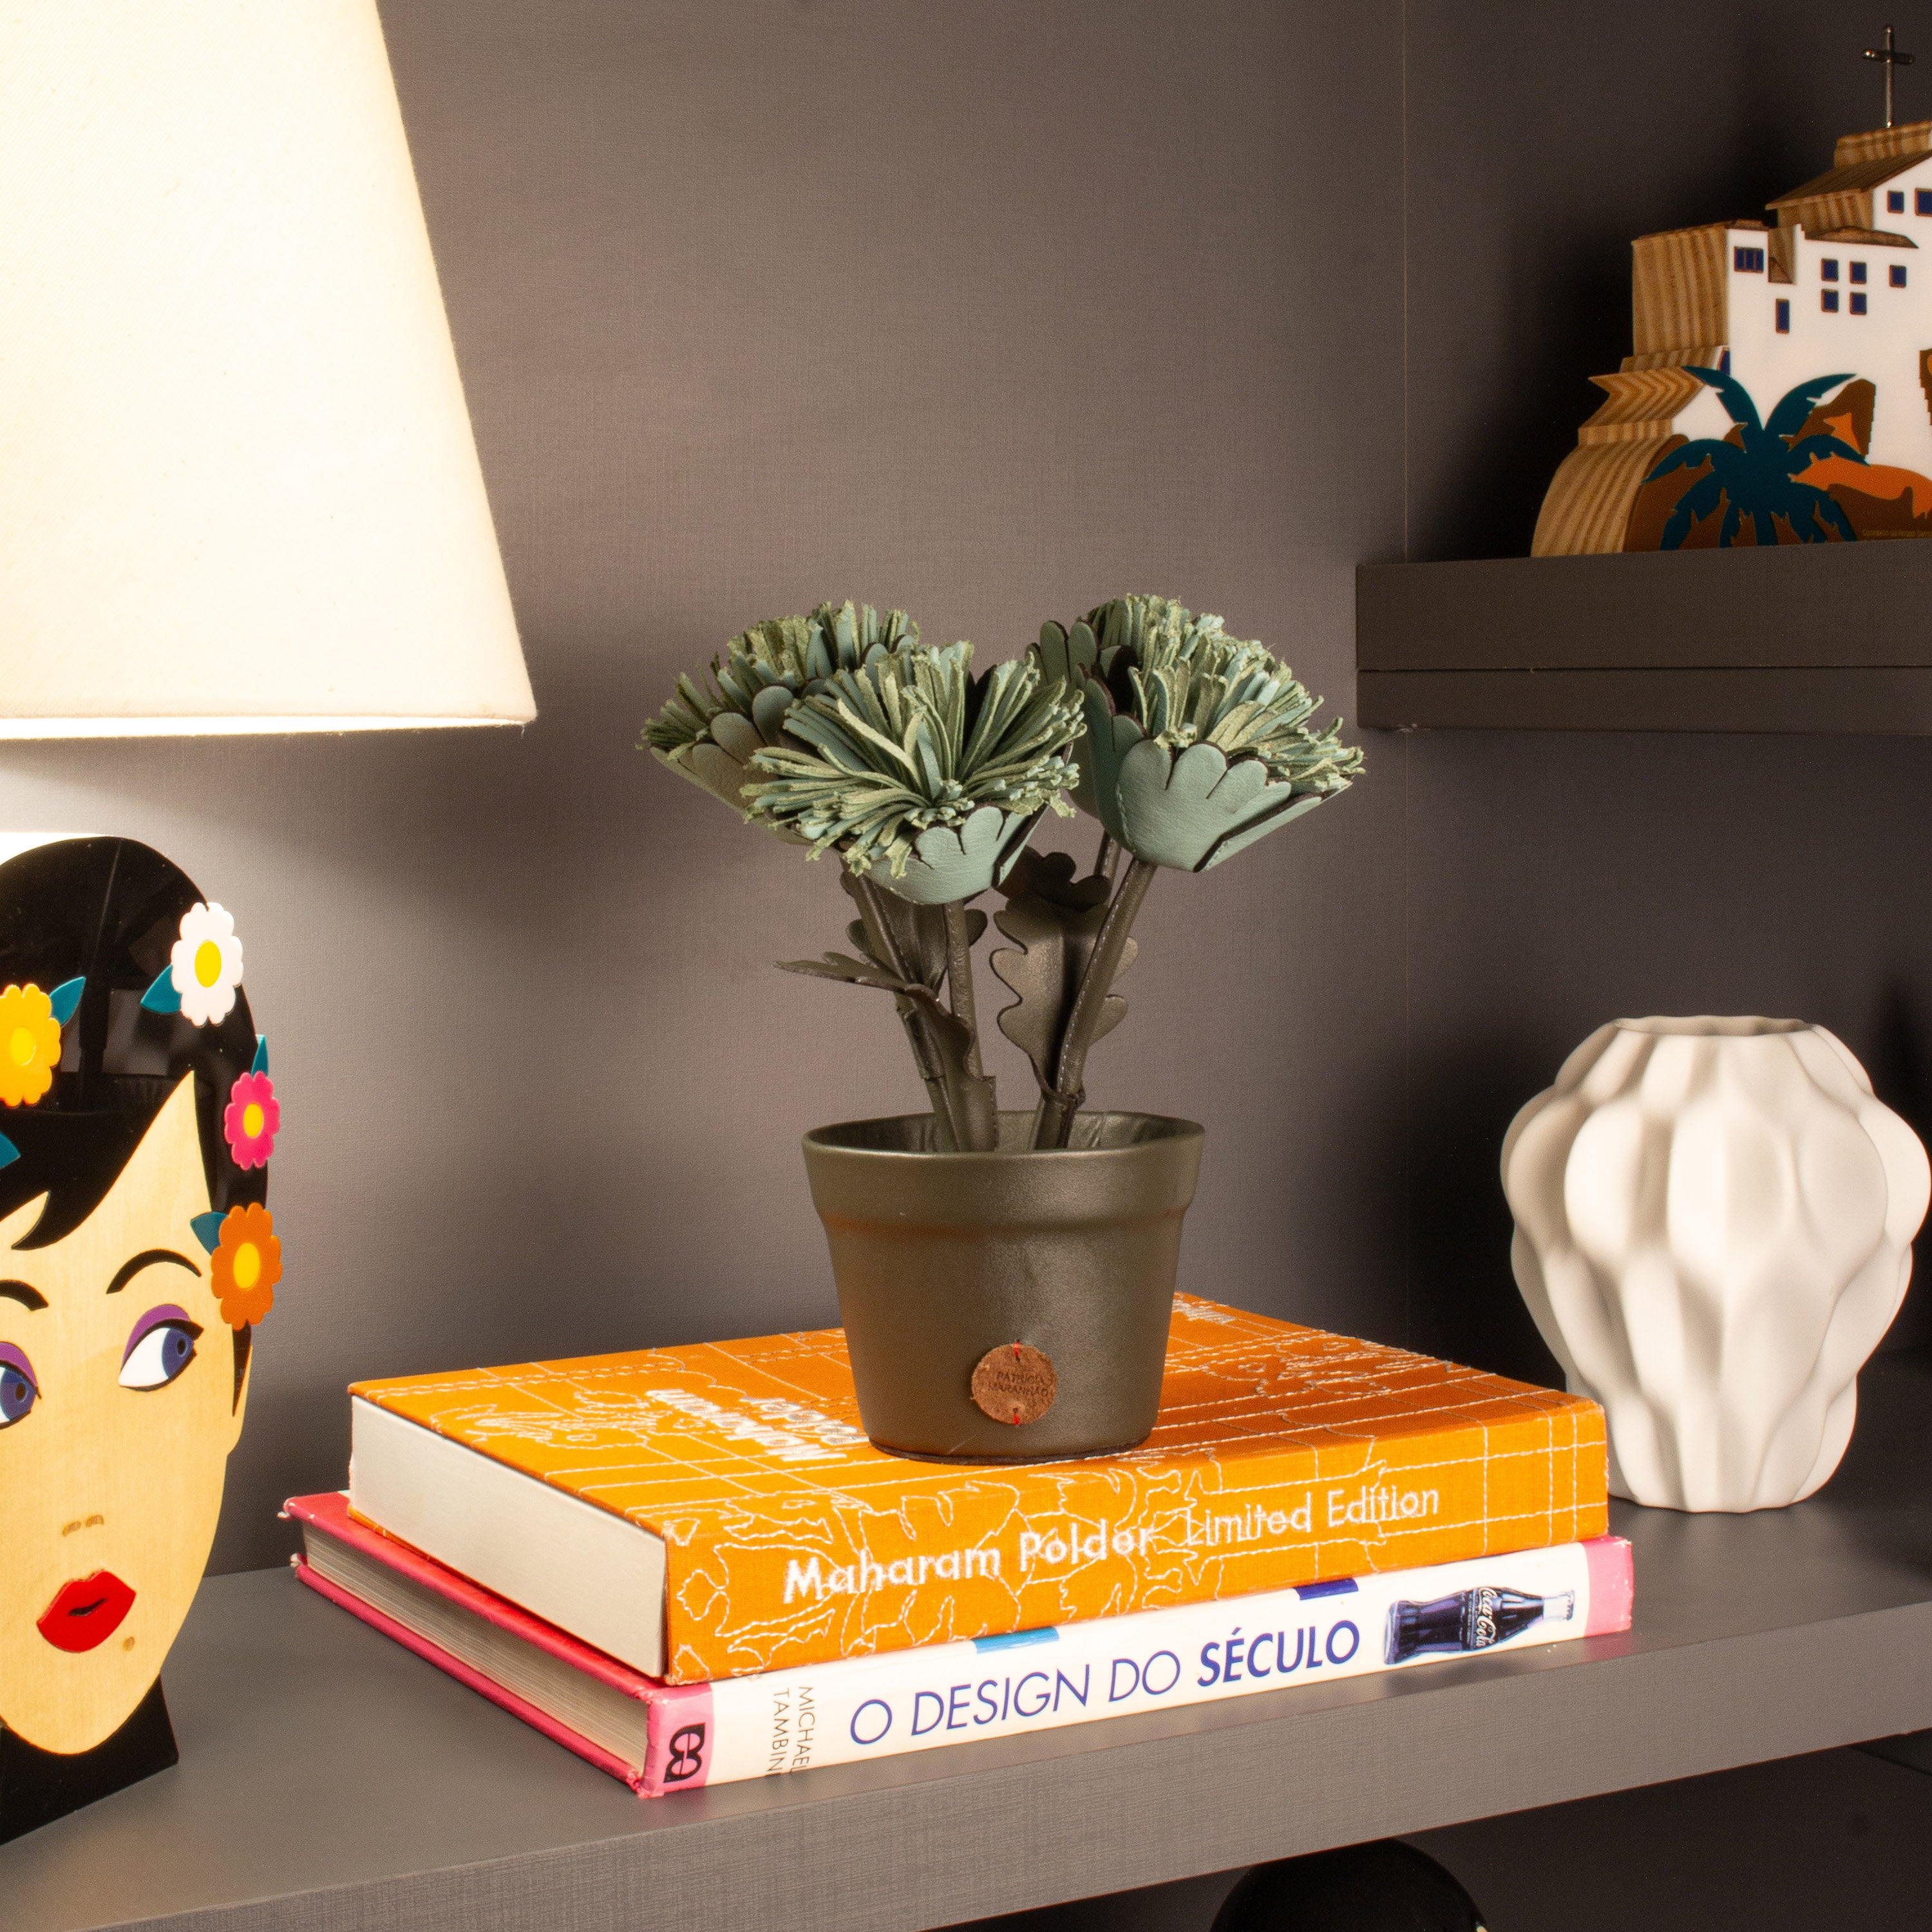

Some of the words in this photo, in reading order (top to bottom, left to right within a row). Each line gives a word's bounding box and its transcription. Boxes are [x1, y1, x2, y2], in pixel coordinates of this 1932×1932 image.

[645, 1388, 847, 1462] Maharam
[783, 1548, 1001, 1604] Maharam
[1019, 1517, 1150, 1572] Polder
[1184, 1490, 1312, 1547] Limited
[1327, 1484, 1440, 1528] Edition
[791, 1685, 816, 1774] MICHAEL
[850, 1698, 893, 1745] O
[911, 1663, 1090, 1737] DESIGN
[1108, 1650, 1182, 1703] DO
[1197, 1619, 1361, 1687] SÉCULO
